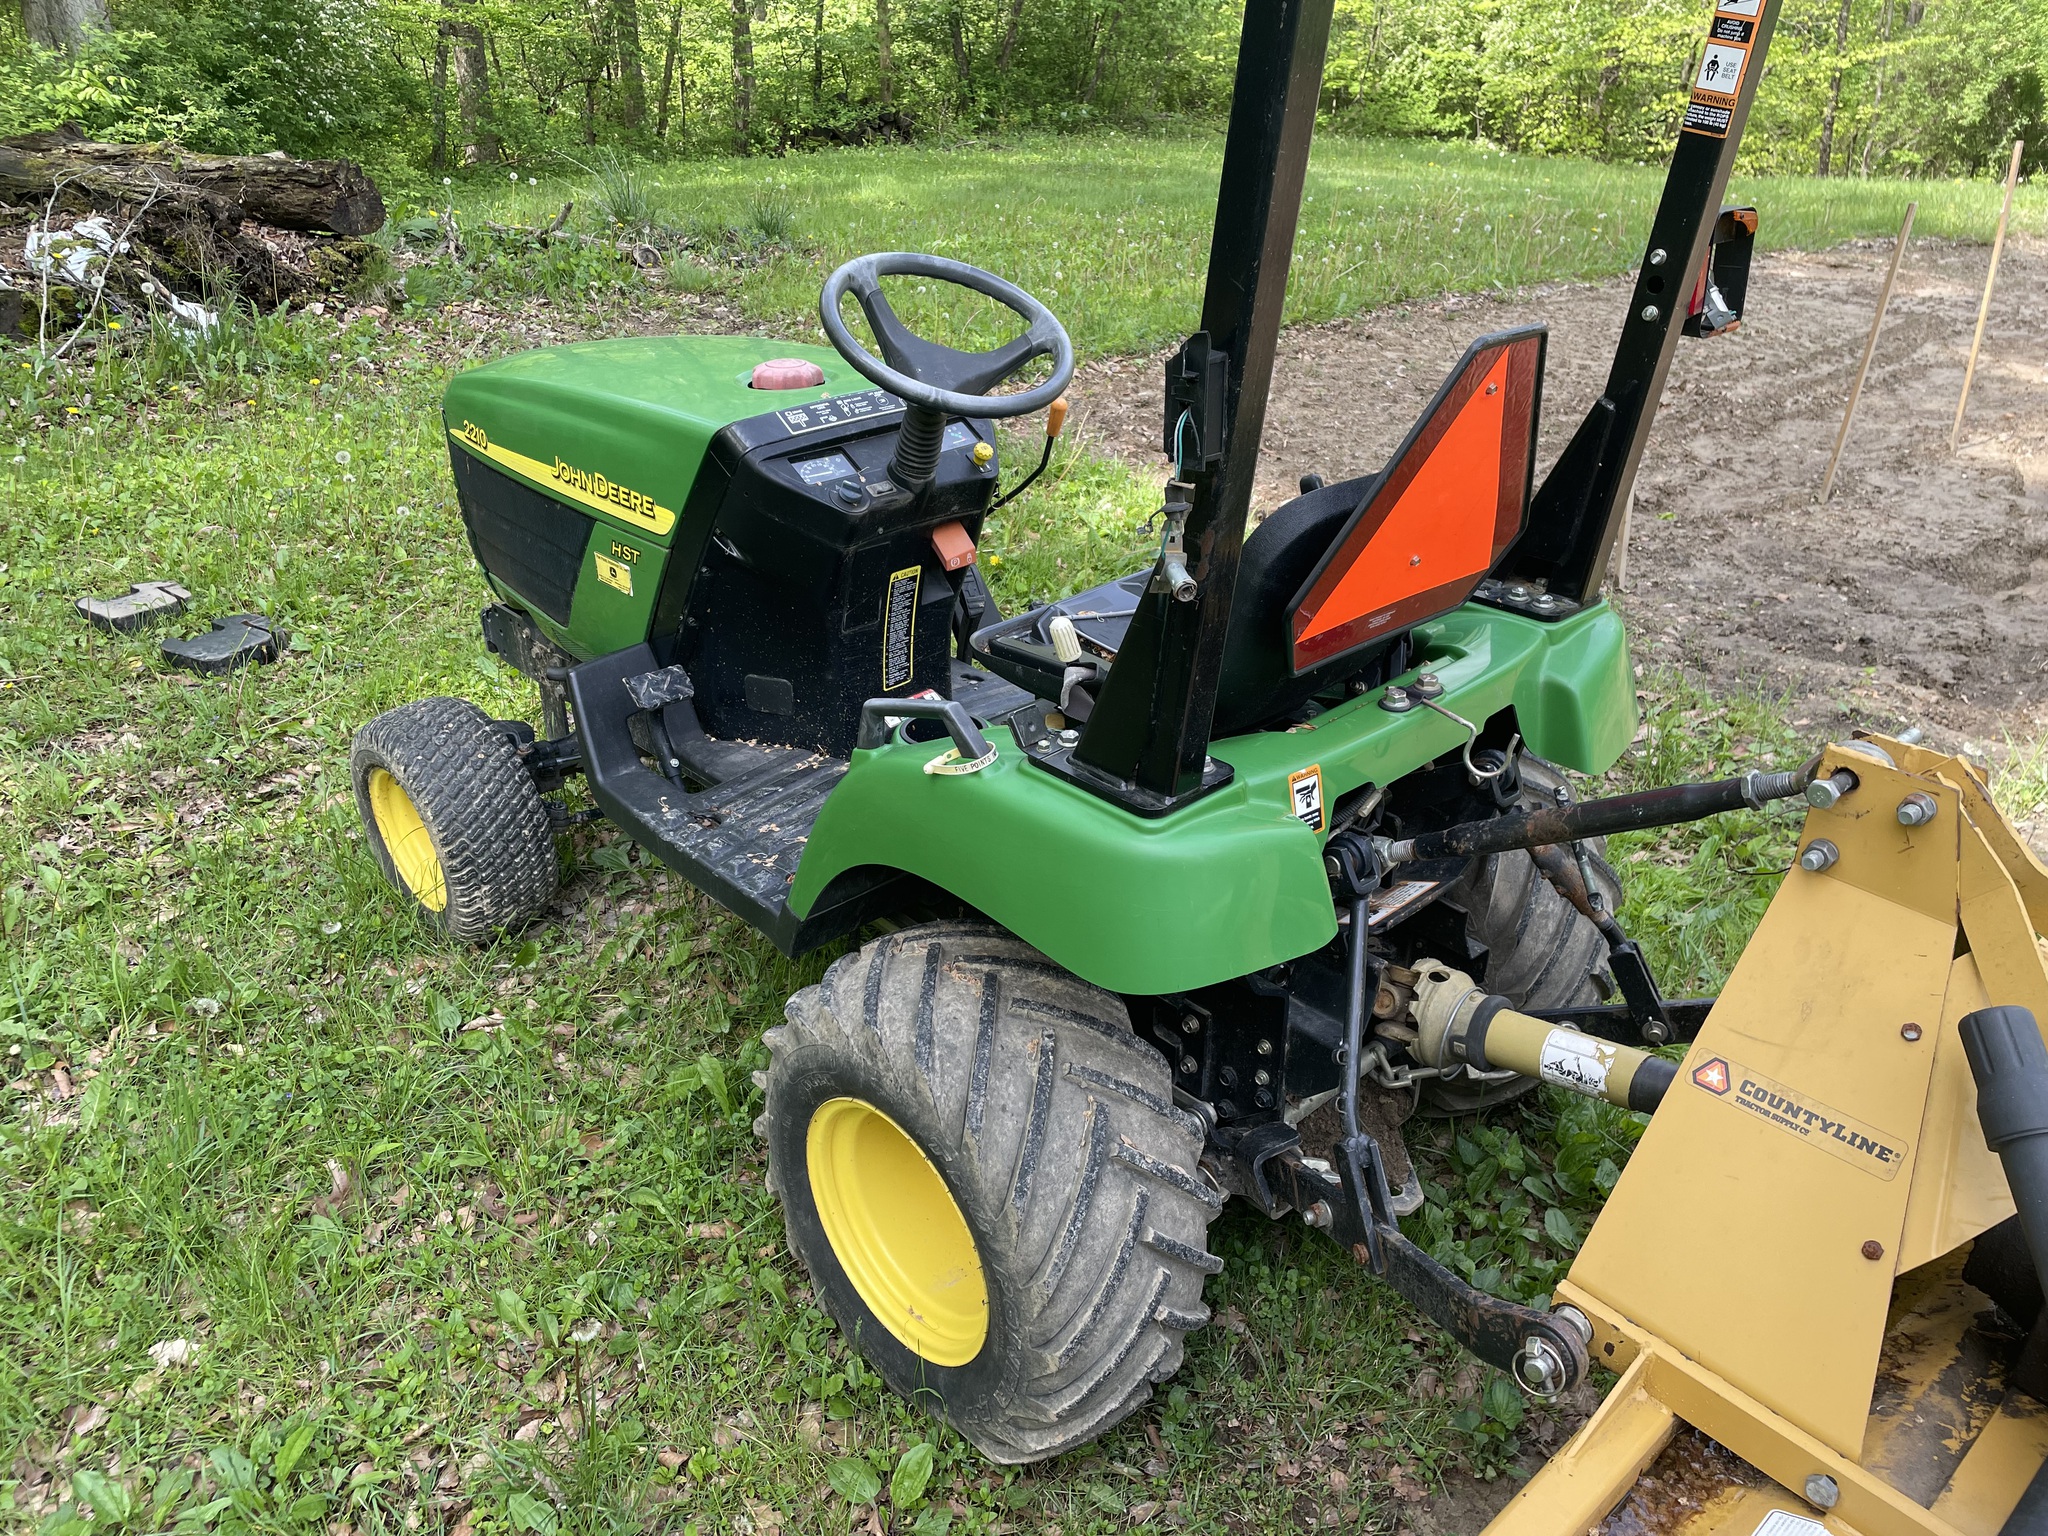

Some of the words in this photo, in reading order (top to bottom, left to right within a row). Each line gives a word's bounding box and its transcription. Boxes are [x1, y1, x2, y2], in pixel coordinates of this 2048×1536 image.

[1693, 92, 1736, 107] WARNING
[463, 420, 488, 451] 2210
[550, 456, 596, 495] JOHN
[594, 472, 656, 521] DEERE
[611, 540, 641, 564] HST
[900, 567, 919, 579] CAUTION
[954, 765, 970, 773] FIVE
[970, 756, 992, 770] POINTS
[1296, 767, 1319, 781] WARNING
[1735, 1095, 1771, 1117] TRACTOR
[1771, 1112, 1800, 1131] SUPPLY
[1739, 1079, 1895, 1163] COUNTYLINE
